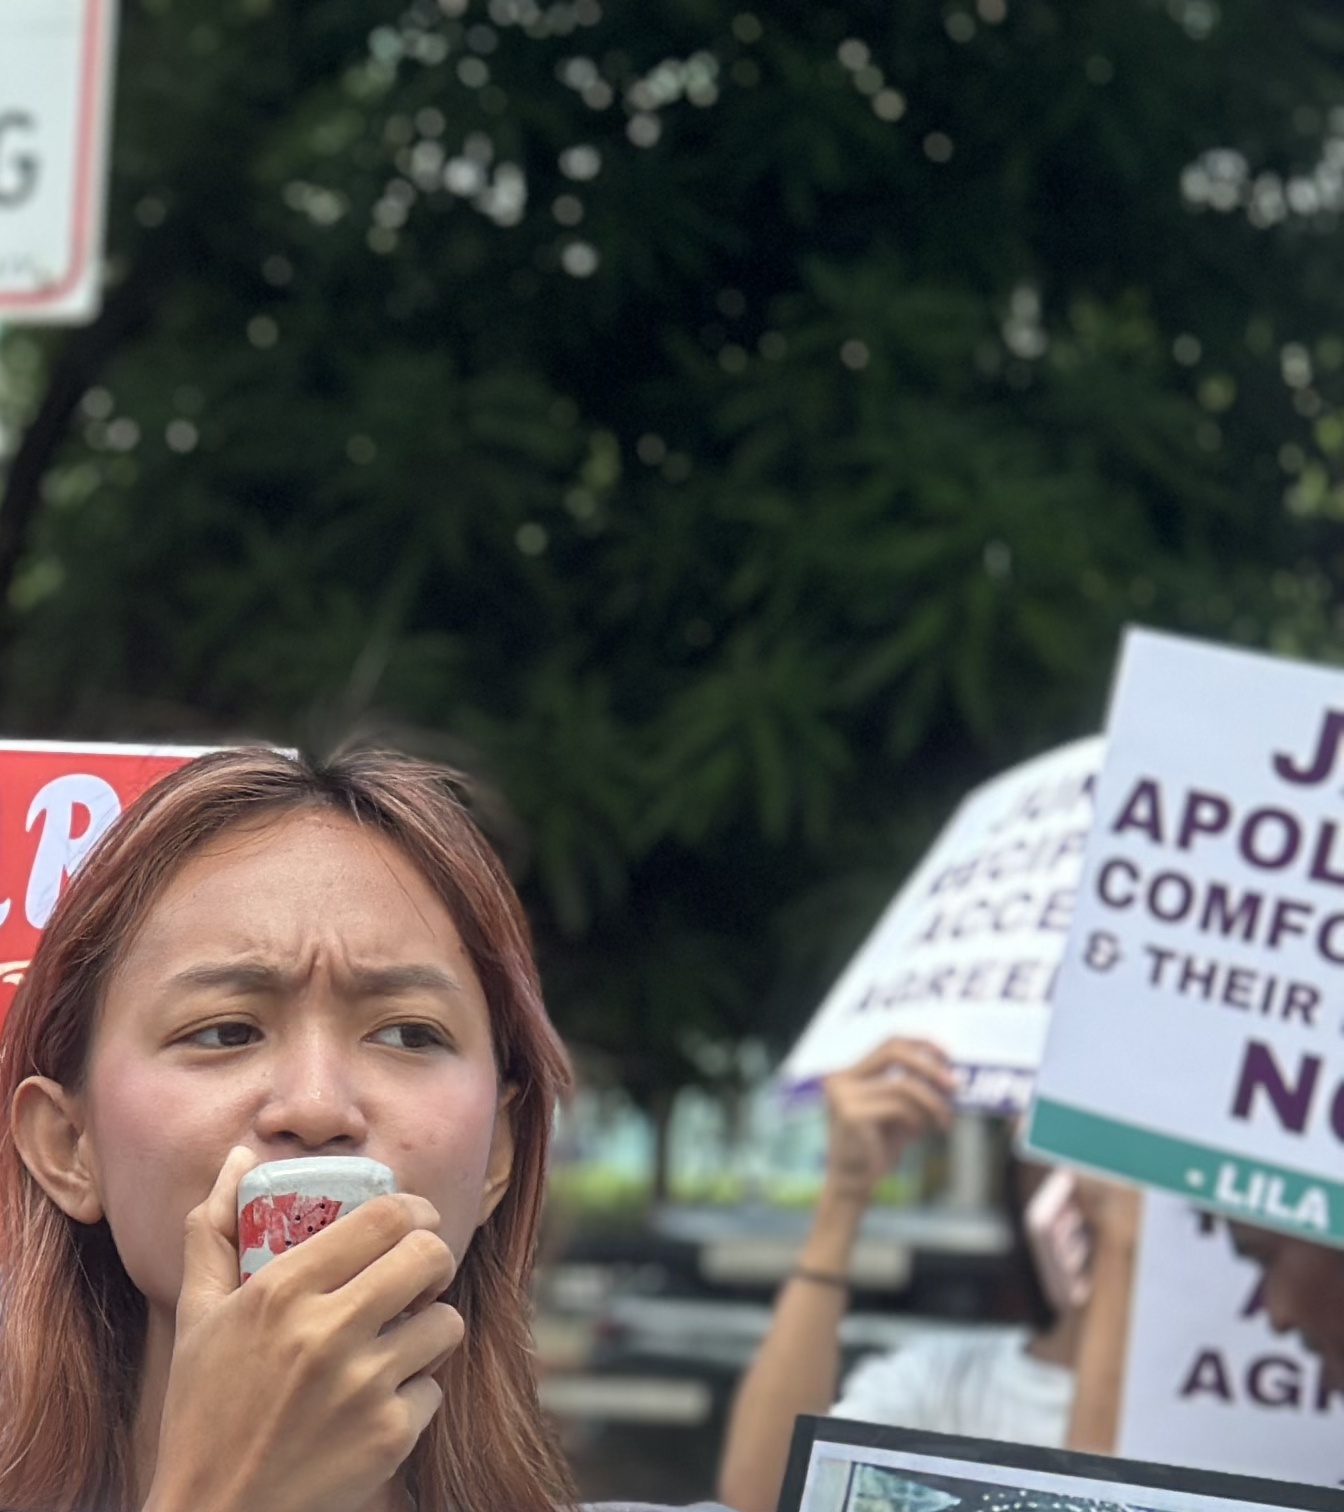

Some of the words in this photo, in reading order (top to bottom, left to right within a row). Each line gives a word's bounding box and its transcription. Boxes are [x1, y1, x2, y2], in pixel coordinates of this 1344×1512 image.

[1084, 930, 1125, 974] &
[1145, 944, 1322, 1026] THEIR
[1229, 1036, 1344, 1148] N
[1216, 1163, 1330, 1230] LILA
